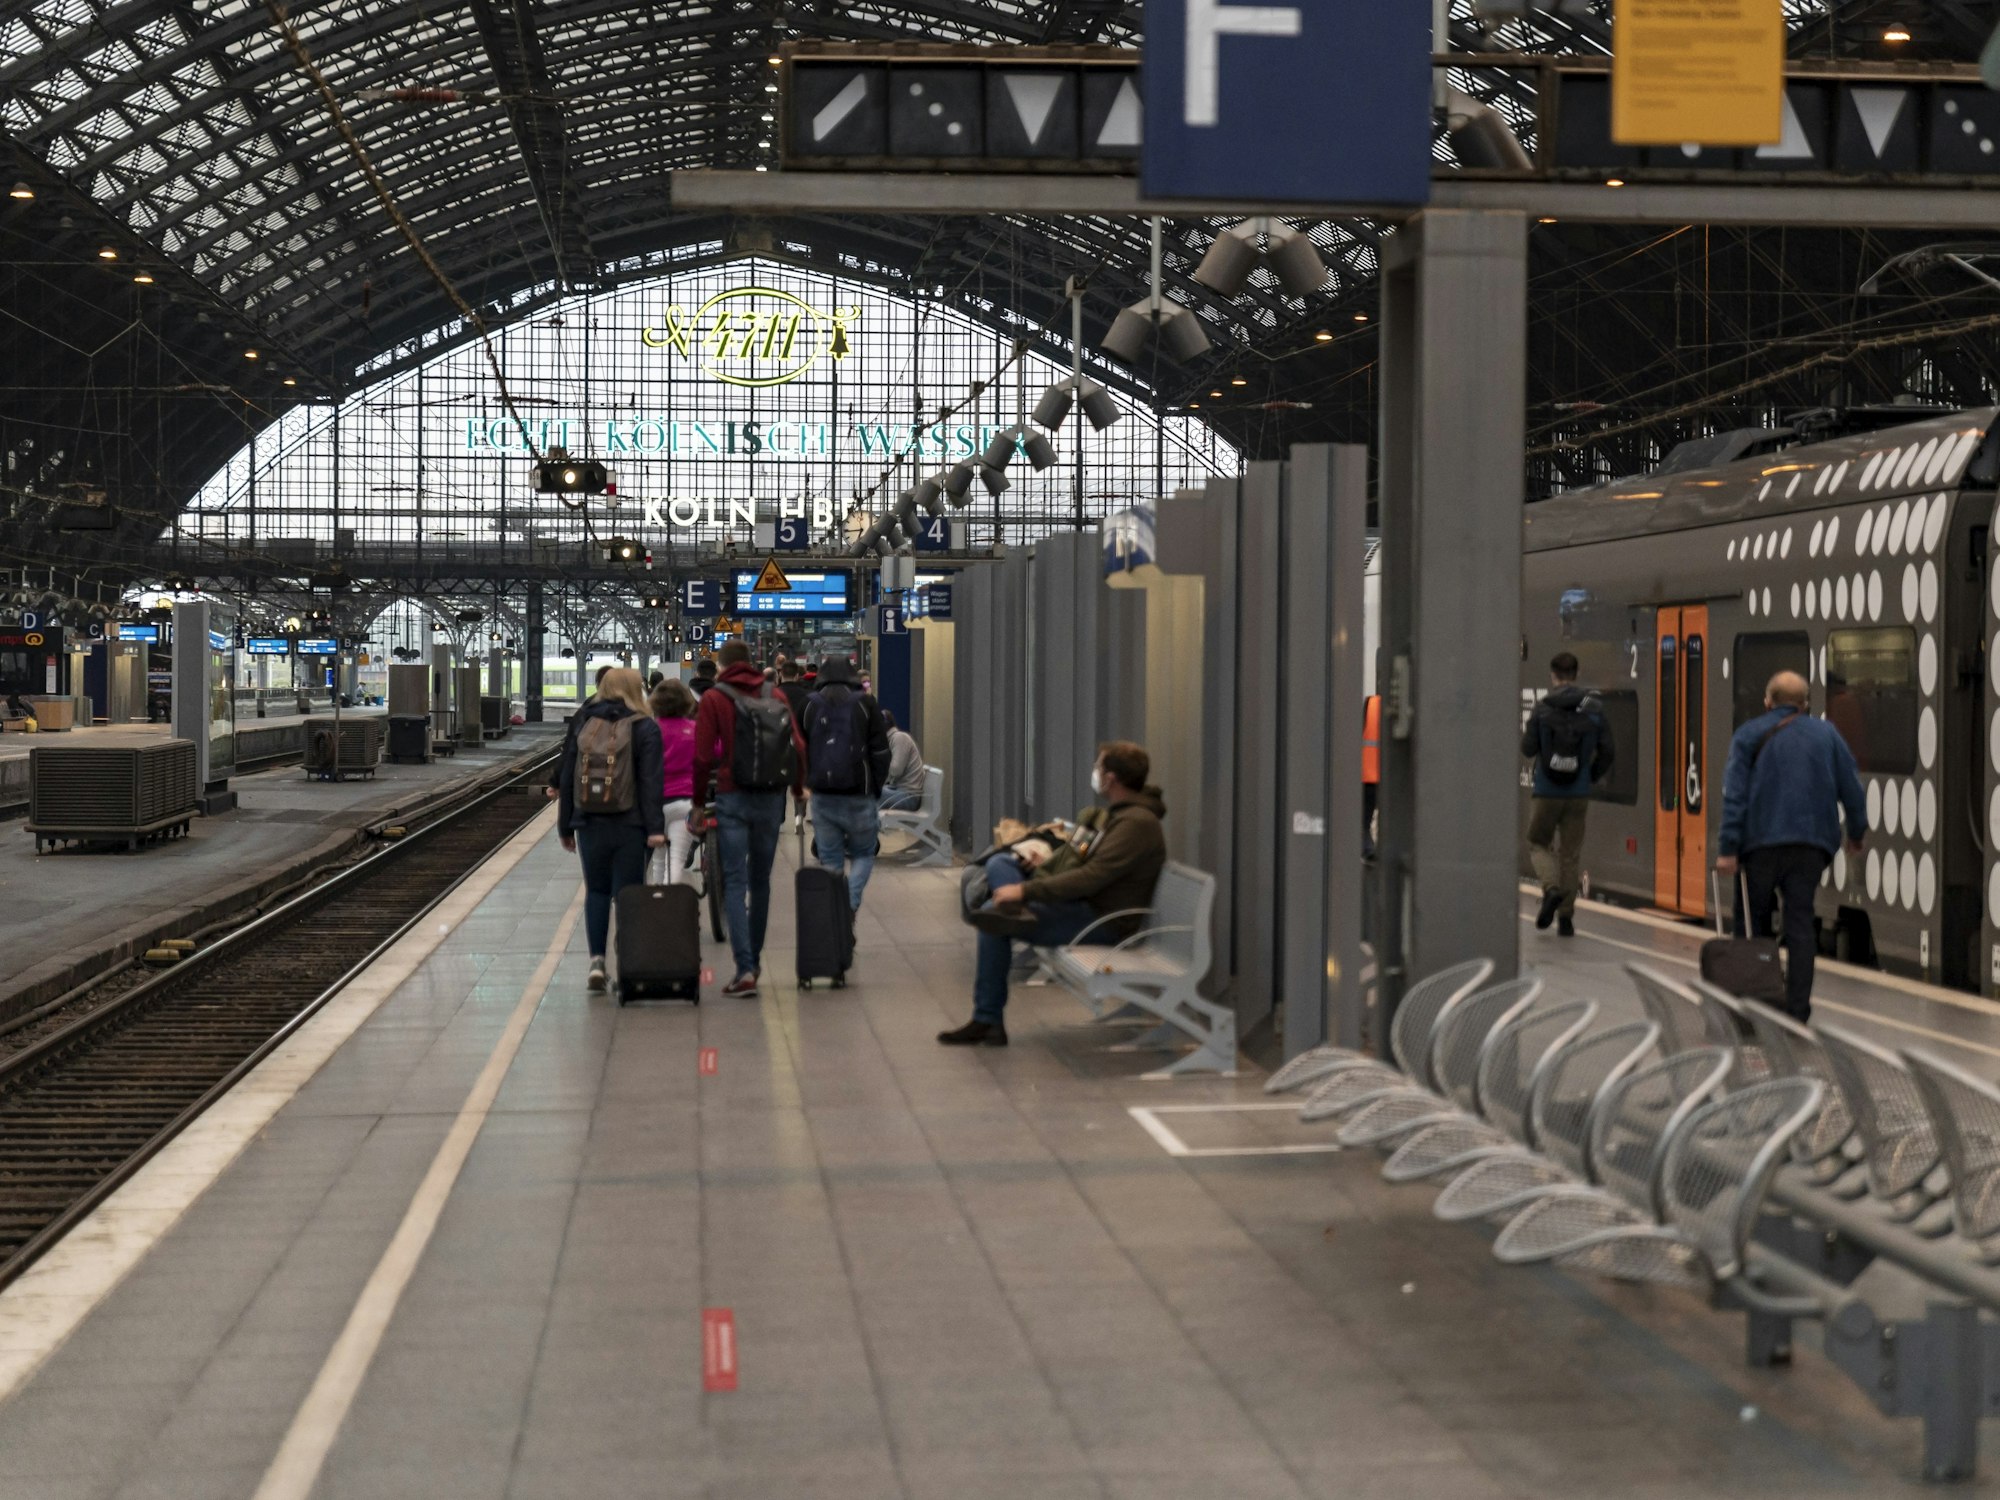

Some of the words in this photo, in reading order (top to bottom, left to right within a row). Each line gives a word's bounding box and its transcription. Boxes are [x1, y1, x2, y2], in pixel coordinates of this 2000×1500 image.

[1184, 0, 1302, 126] F
[702, 311, 801, 360] 4711
[606, 415, 827, 455] KÖLNISCH
[644, 495, 756, 528] KÖLN
[780, 518, 796, 543] 5
[927, 518, 944, 544] 4
[687, 580, 705, 609] E
[23, 612, 37, 629] D
[89, 624, 99, 636] C
[692, 625, 704, 641] D
[684, 650, 693, 661] B
[1630, 643, 1638, 679] 2
